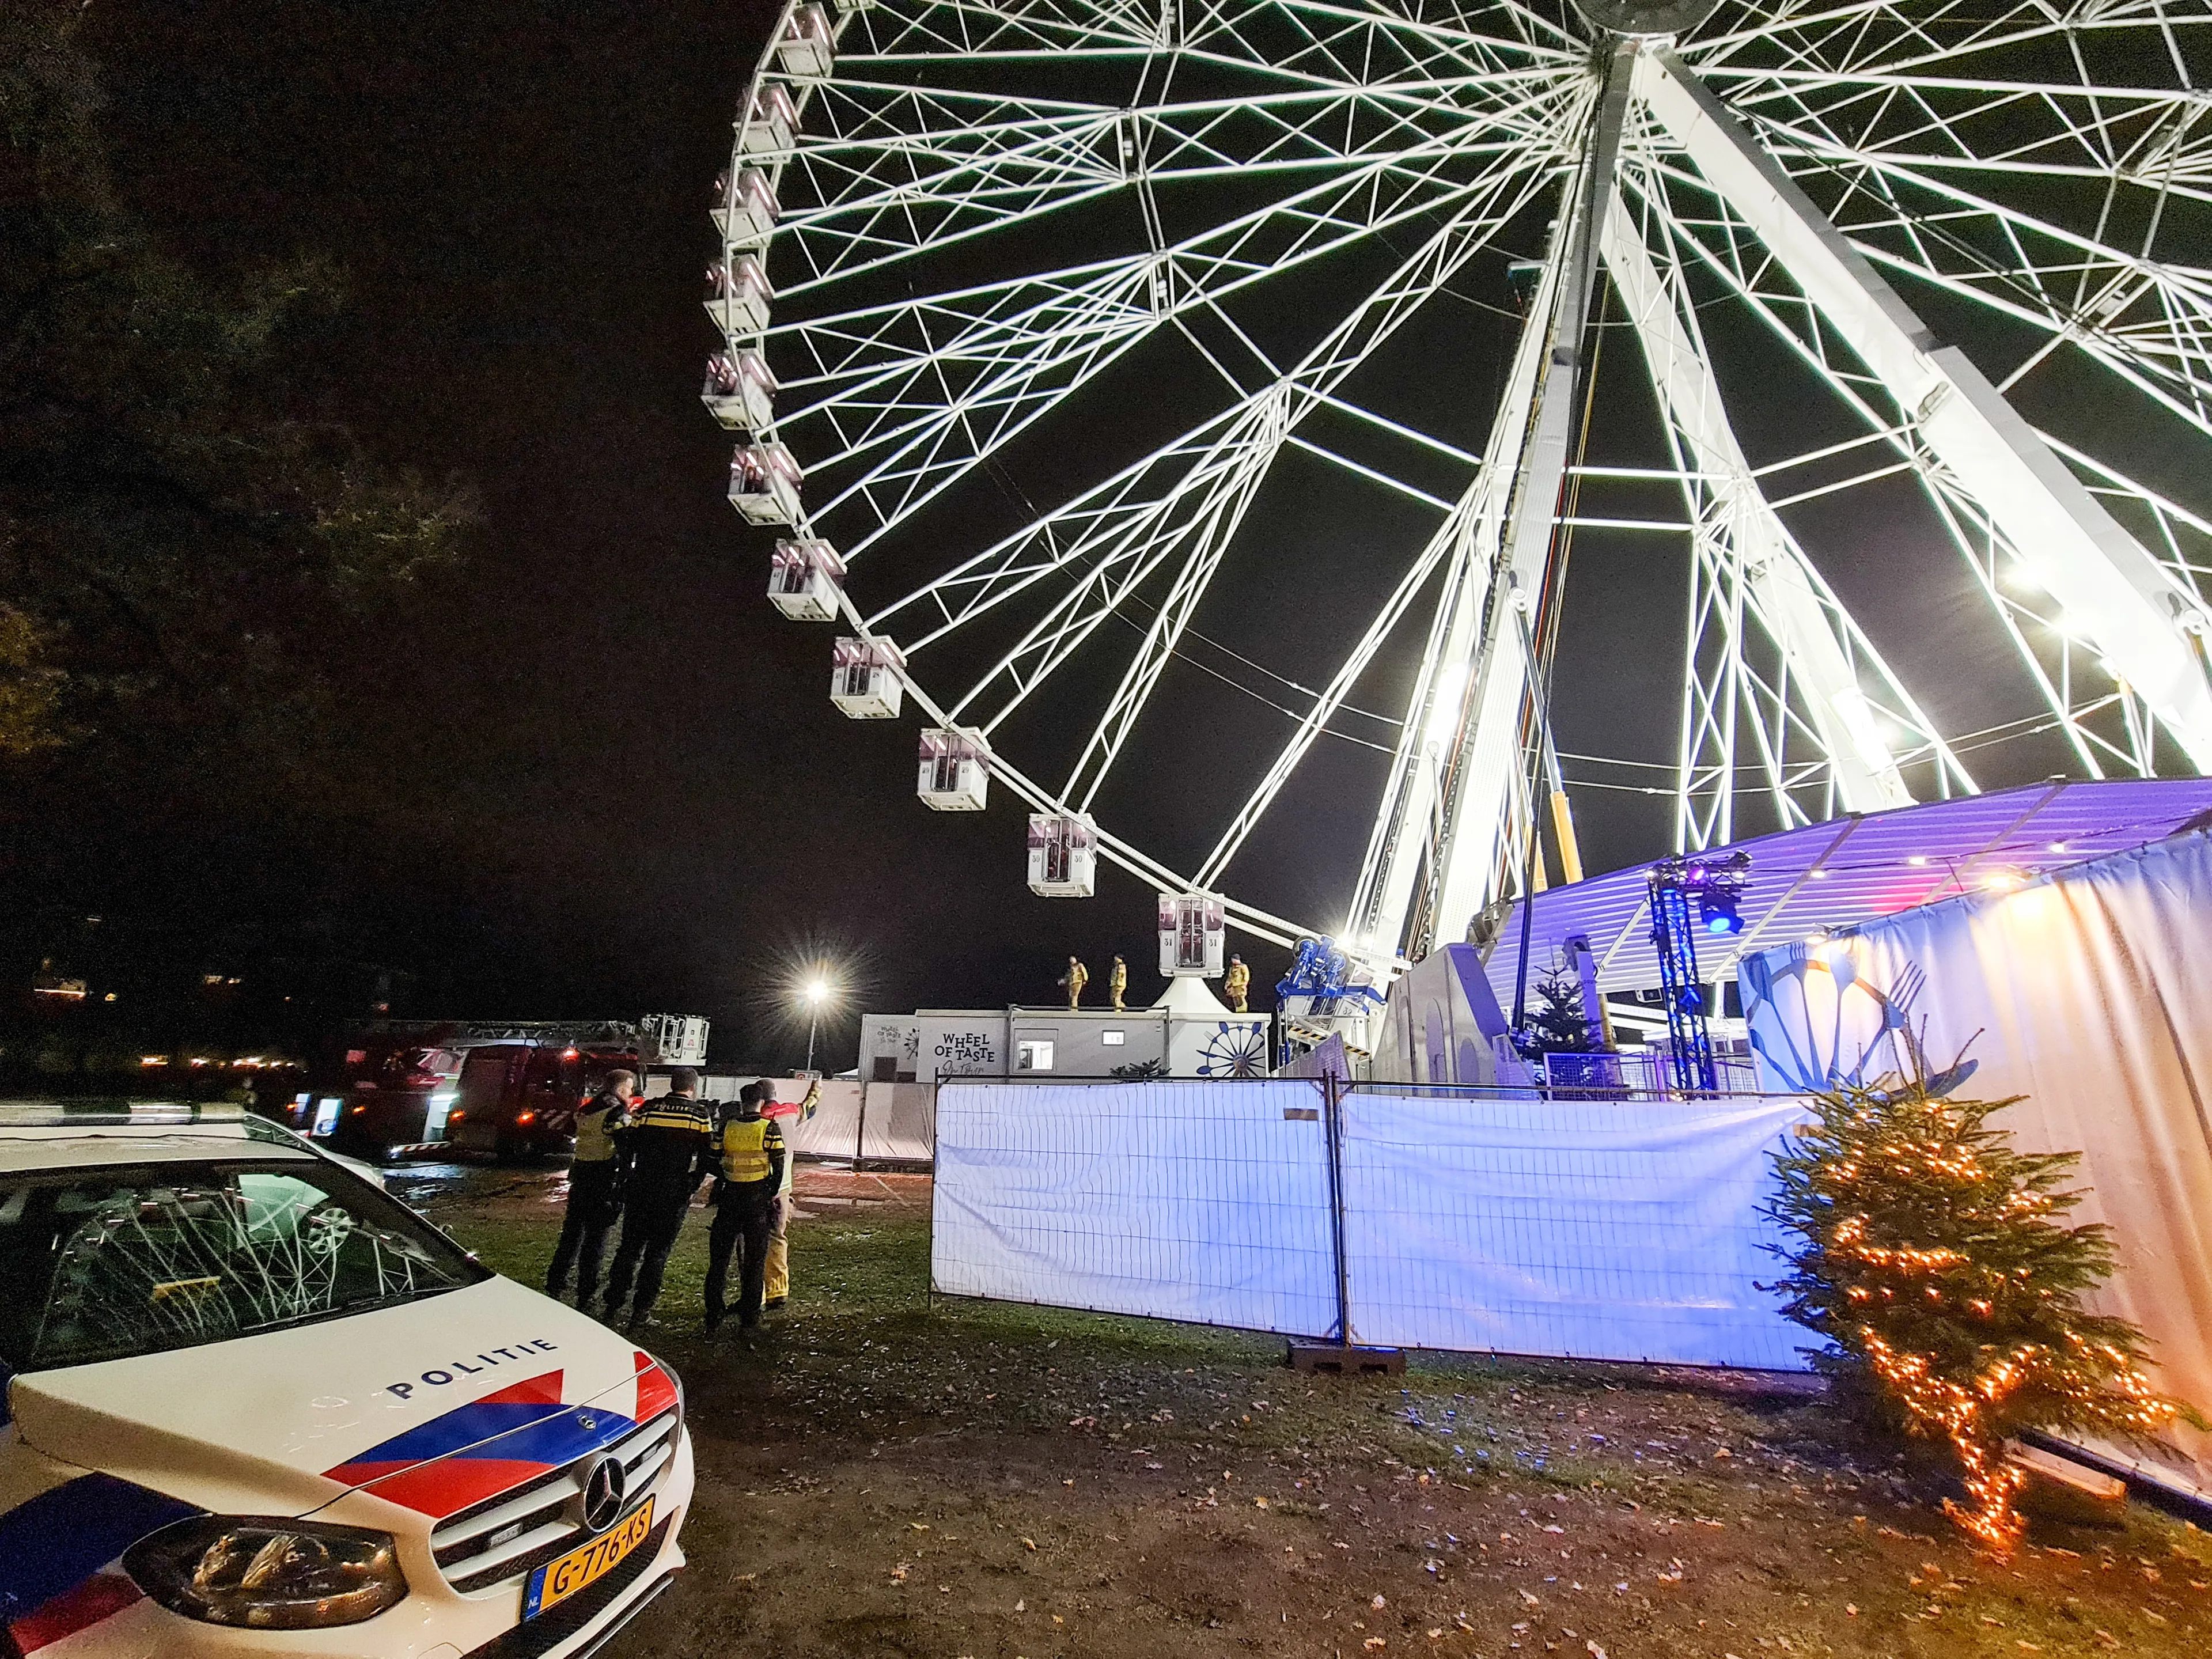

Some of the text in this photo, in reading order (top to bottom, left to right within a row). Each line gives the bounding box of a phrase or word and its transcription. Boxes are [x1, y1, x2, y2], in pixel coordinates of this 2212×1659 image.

[1032, 855, 1040, 863] 30
[1074, 855, 1083, 863] 30
[1164, 938, 1172, 946] 31
[943, 1033, 990, 1048] WHEEL
[934, 1045, 995, 1062] OF TASTE
[386, 1339, 558, 1399] POLITIE
[554, 1508, 647, 1594] G-776-KS
[528, 1596, 539, 1609] NL
